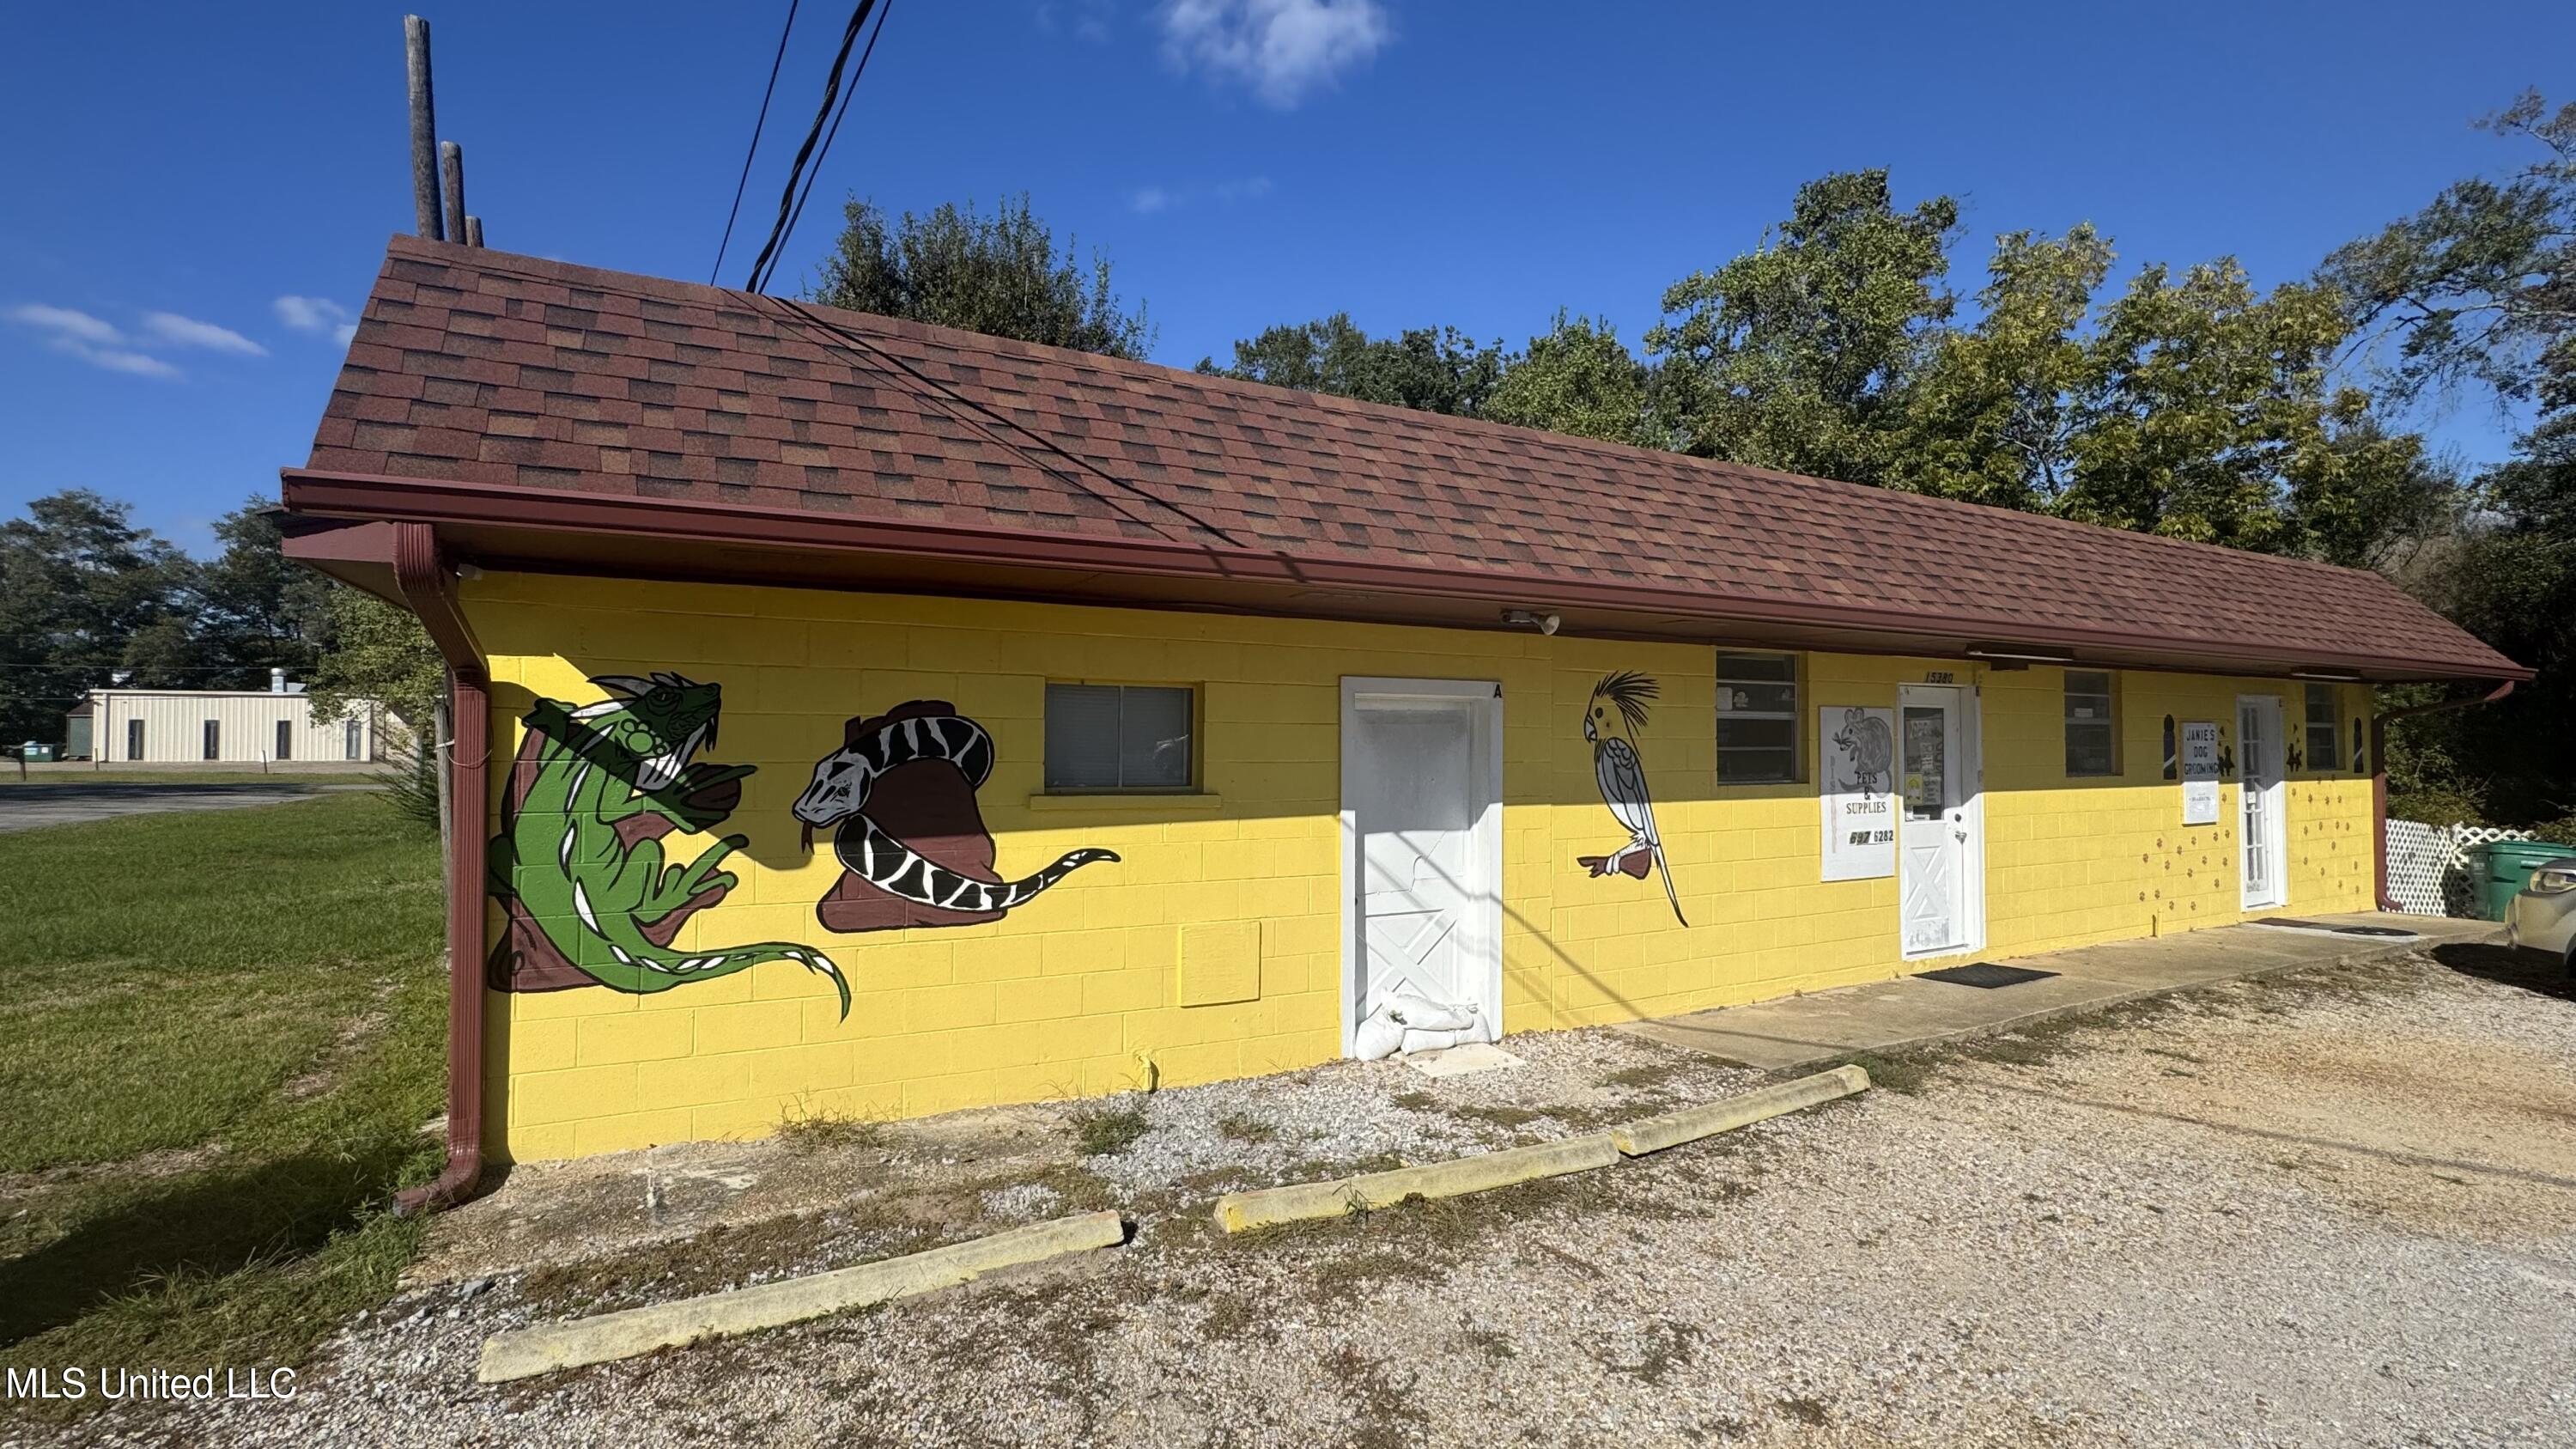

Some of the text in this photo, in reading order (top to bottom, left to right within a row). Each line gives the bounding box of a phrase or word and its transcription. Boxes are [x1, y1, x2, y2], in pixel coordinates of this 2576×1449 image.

[1926, 672, 1953, 684] 15380
[1493, 684, 1502, 698] A
[2193, 746, 2208, 758] DOG
[2184, 763, 2219, 775] GROOMING
[1856, 772, 1878, 784] PETS
[1846, 801, 1886, 814] SUPPLIES
[1874, 830, 1894, 842] 6282
